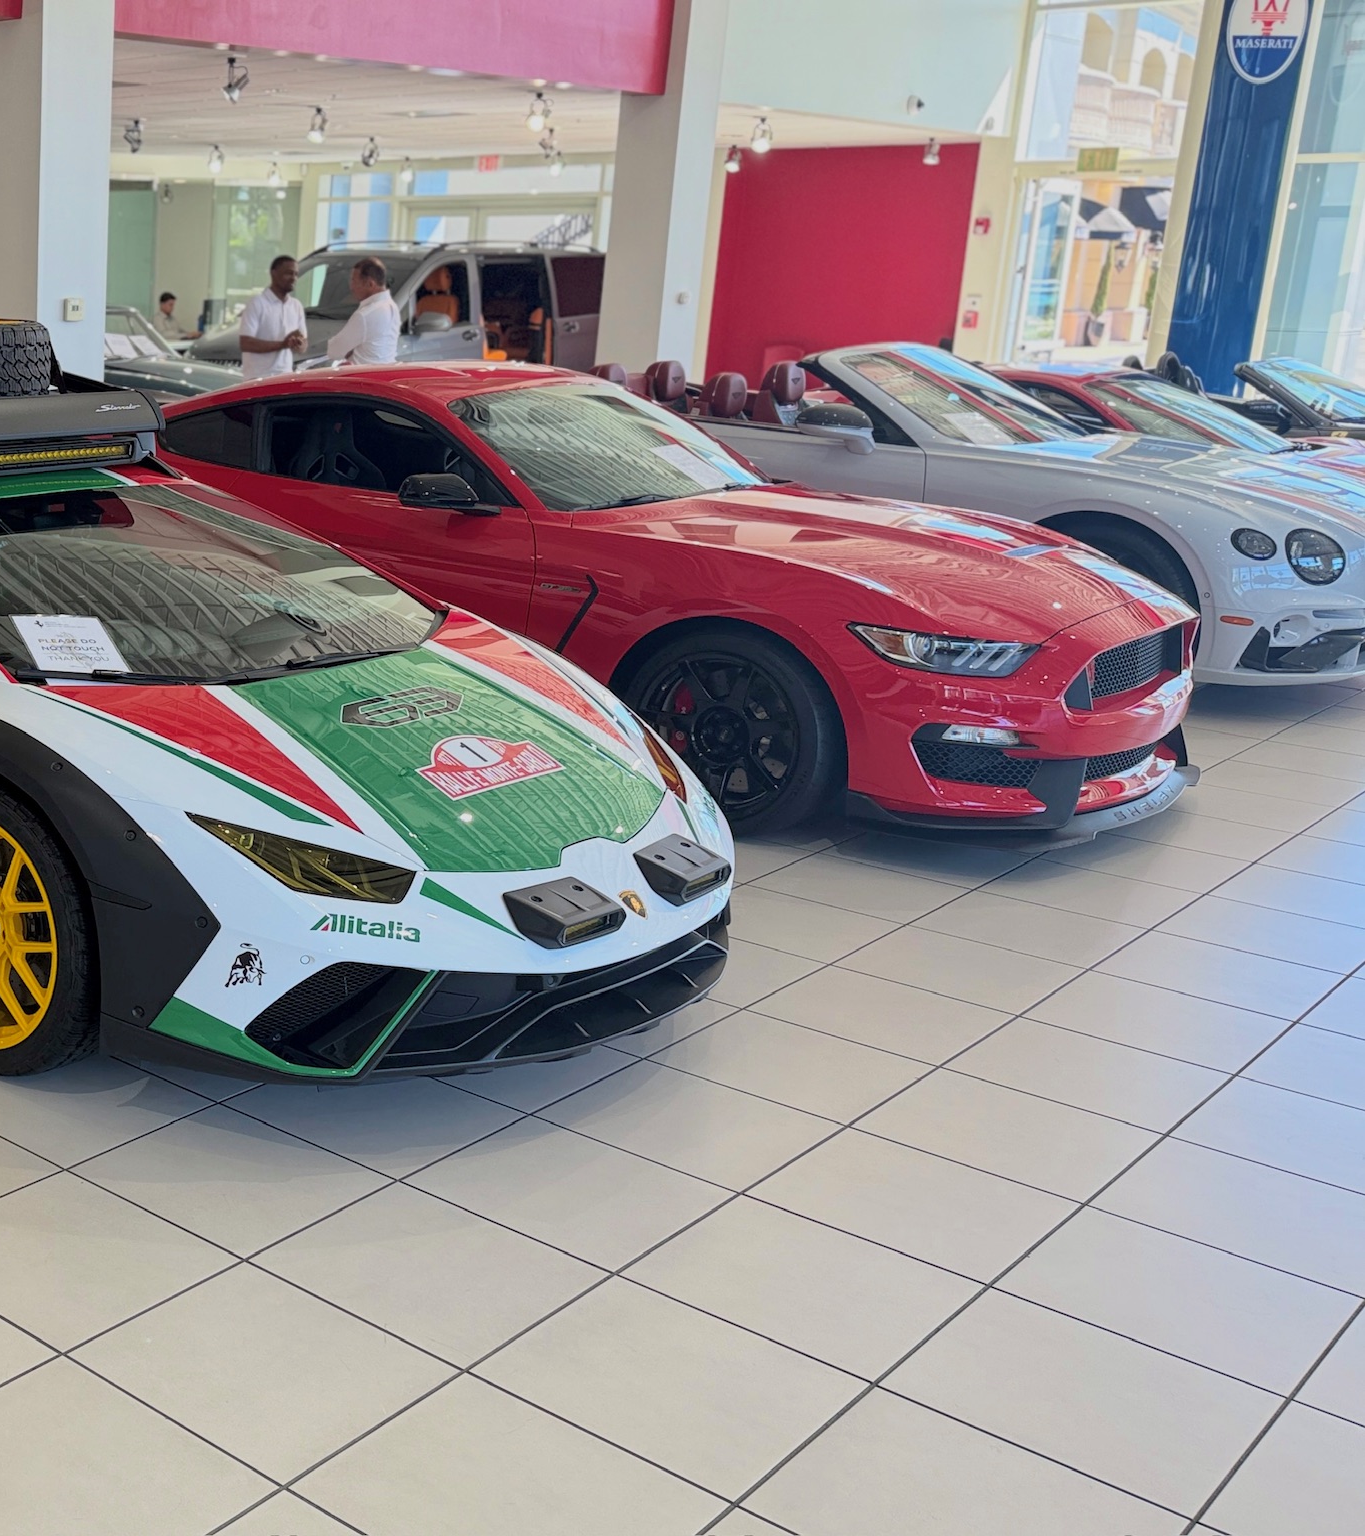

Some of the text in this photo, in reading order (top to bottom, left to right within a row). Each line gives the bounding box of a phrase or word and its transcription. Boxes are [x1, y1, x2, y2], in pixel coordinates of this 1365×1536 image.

[1235, 38, 1294, 49] MASERATI
[340, 685, 464, 728] 63
[460, 741, 488, 762] 1
[423, 743, 558, 795] RALLYE MONTE-CARLO
[1113, 784, 1175, 822] SHELBY
[310, 913, 420, 943] Alitalia
